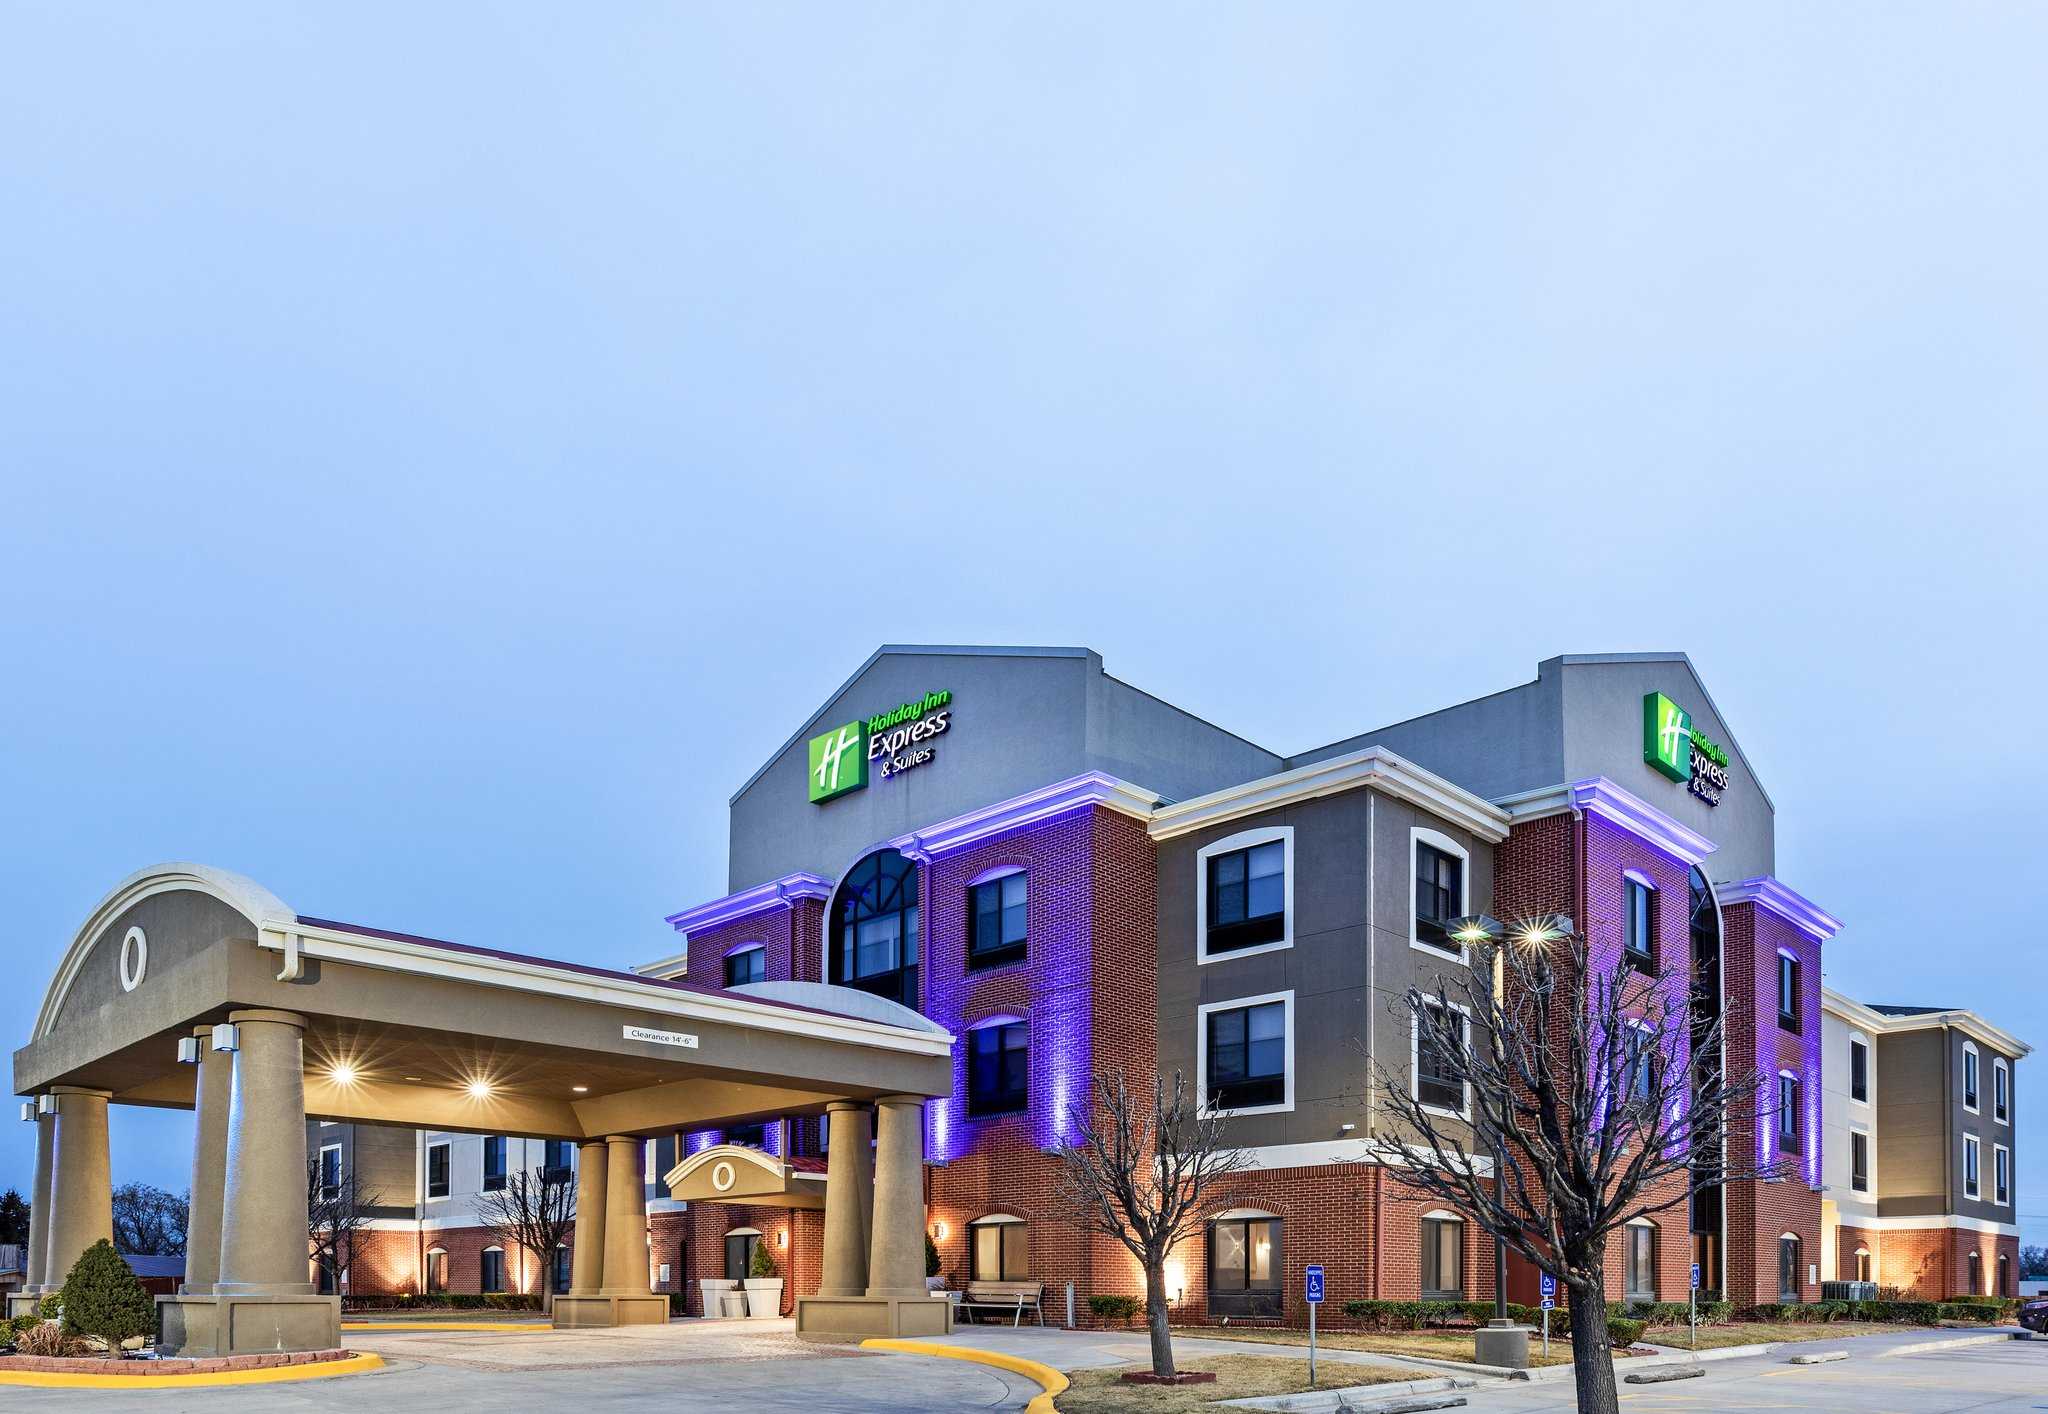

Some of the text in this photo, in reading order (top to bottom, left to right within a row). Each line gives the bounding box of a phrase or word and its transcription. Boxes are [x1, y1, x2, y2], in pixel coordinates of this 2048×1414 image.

[867, 690, 951, 735] Holiday Inn
[868, 711, 949, 761] Express
[880, 747, 932, 778] & Suites
[1716, 745, 1729, 767] Inn
[1693, 776, 1721, 807] & Suites
[631, 1029, 670, 1042] Clearance
